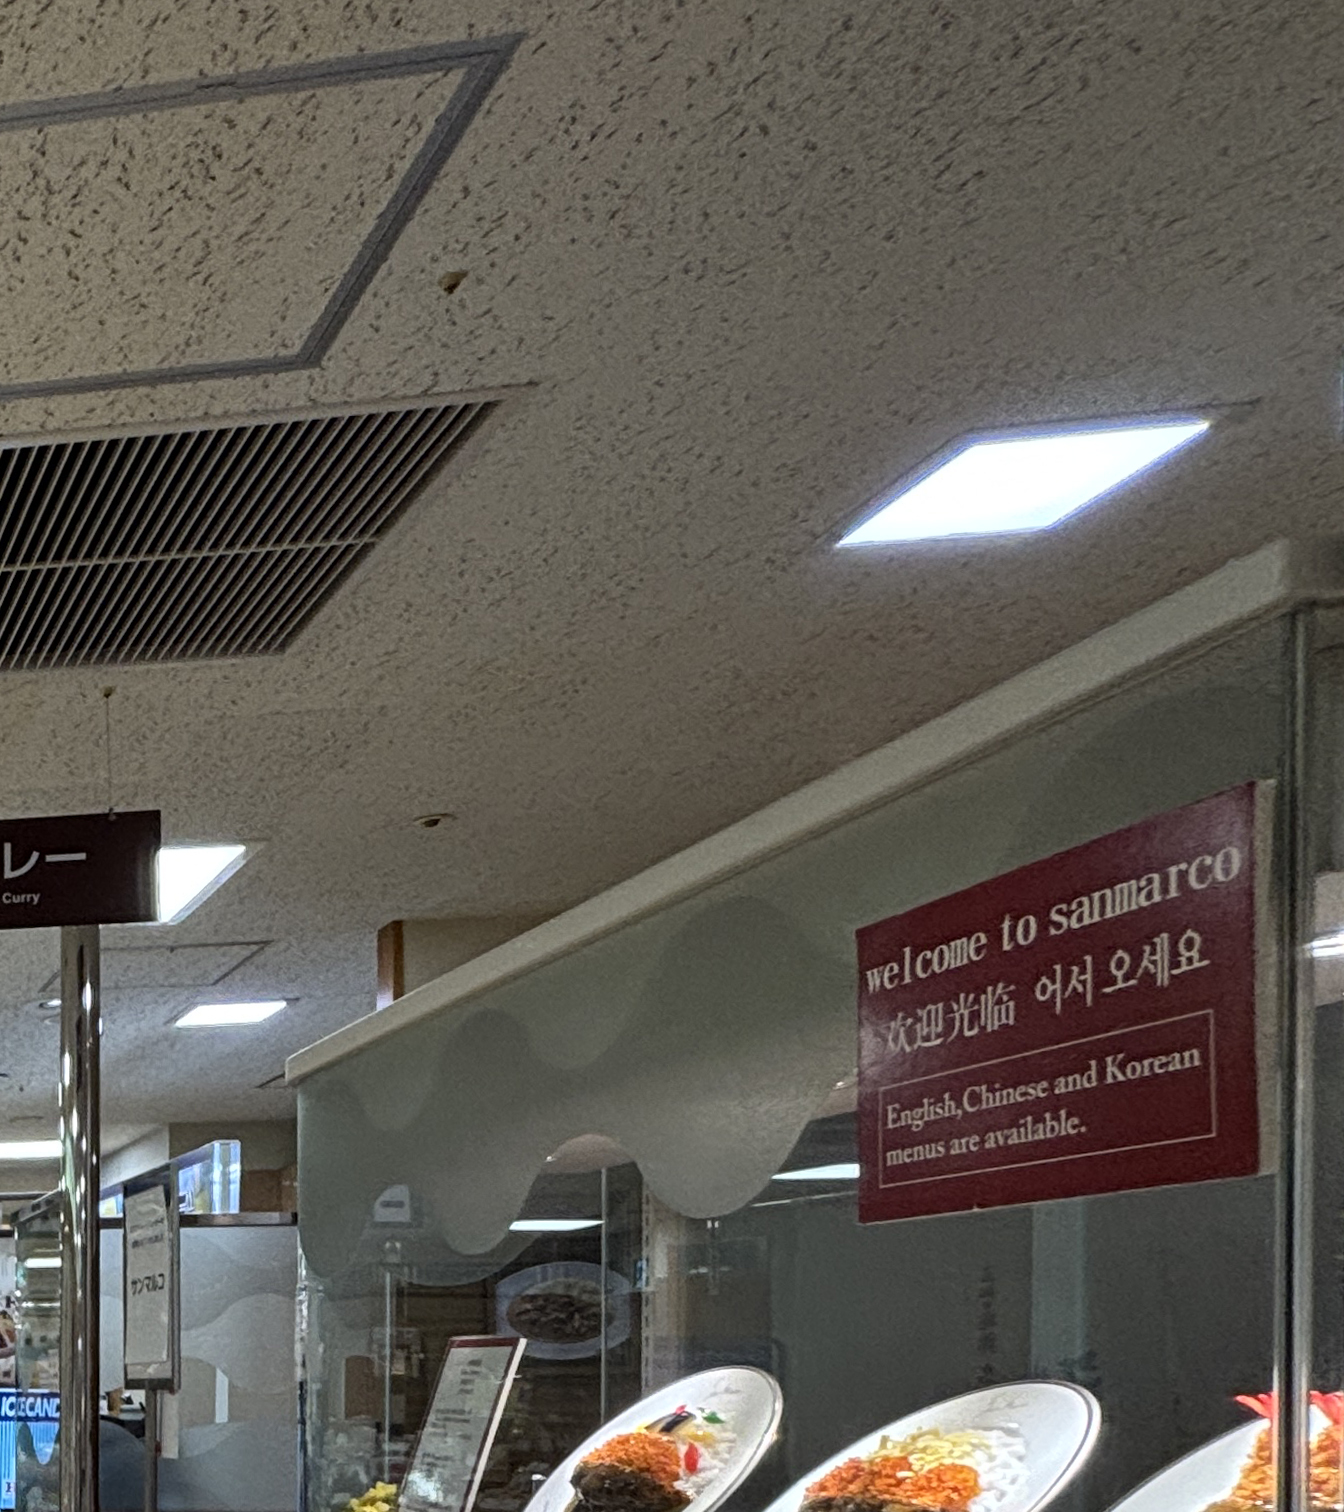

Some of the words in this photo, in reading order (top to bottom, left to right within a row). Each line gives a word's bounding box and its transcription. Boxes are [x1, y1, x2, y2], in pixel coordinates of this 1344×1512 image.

[2, 891, 40, 905] Curry
[865, 931, 988, 995] welcome
[1001, 911, 1038, 953] to
[1049, 845, 1243, 937] sanmarco
[1034, 953, 1094, 1016] 어서
[1100, 928, 1211, 996] 오세요
[886, 982, 1017, 1054] 欢迎光临
[1053, 1059, 1098, 1096] and
[1105, 1047, 1202, 1087] Korean
[885, 1136, 946, 1167] menus
[950, 1130, 981, 1156] are
[984, 1110, 1088, 1150] available.
[131, 1273, 165, 1296] サンマルコ
